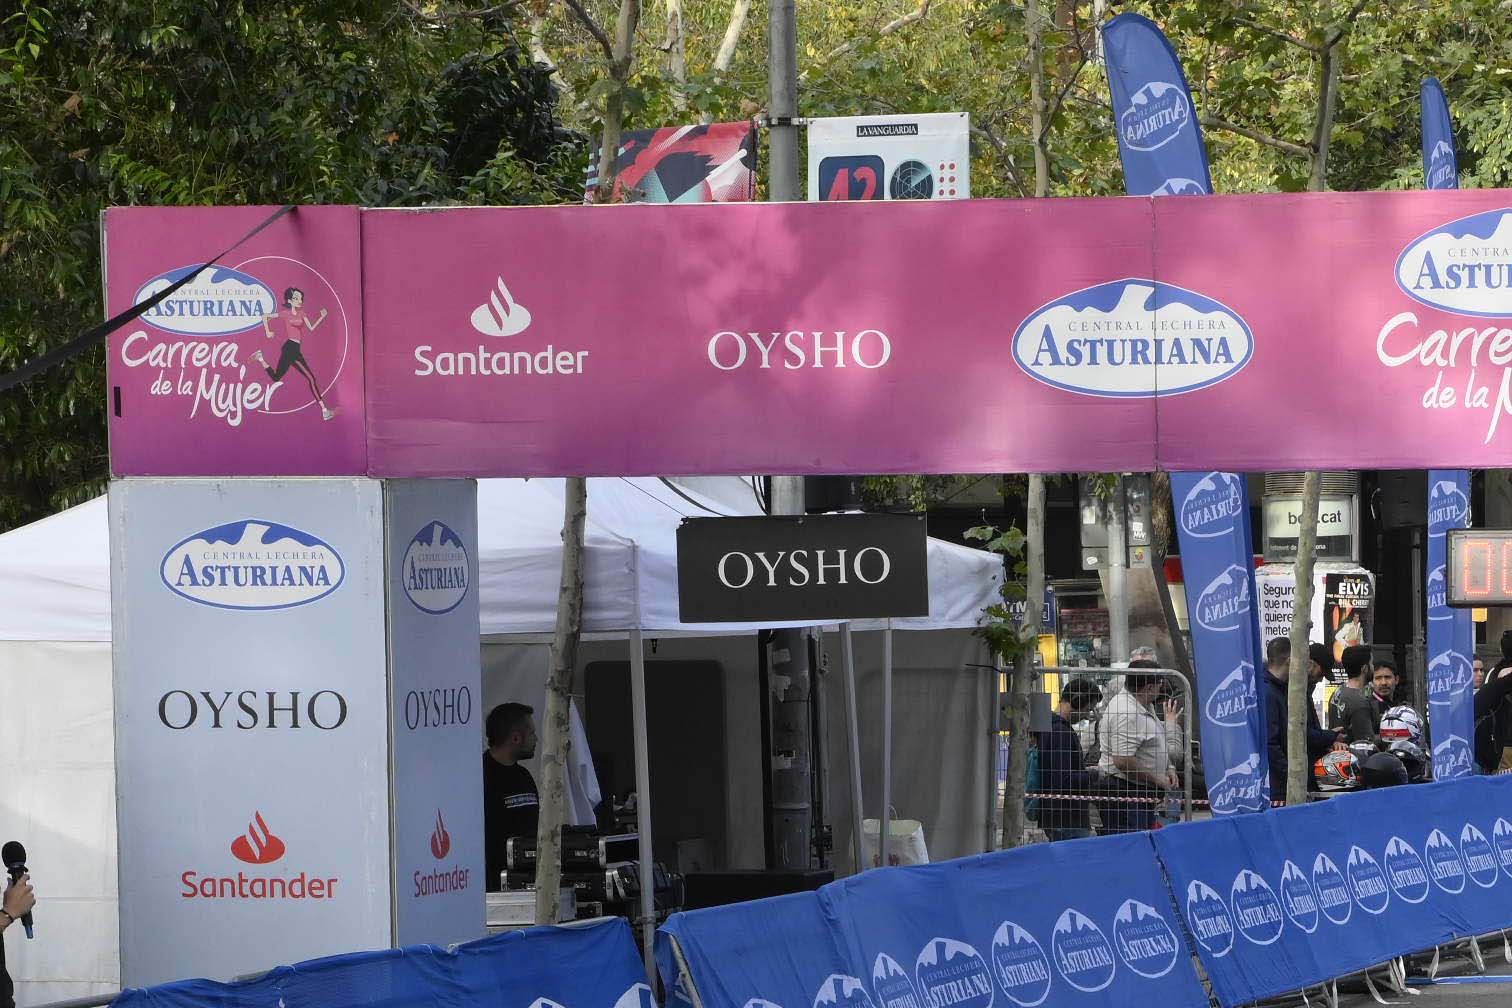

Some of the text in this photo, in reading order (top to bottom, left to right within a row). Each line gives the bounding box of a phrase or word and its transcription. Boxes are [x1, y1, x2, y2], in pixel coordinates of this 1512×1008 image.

[858, 125, 917, 135] LA VANGUARDIA
[1068, 319, 1228, 332] CENTRAL LECHERA
[121, 330, 240, 368] Carrera
[413, 344, 590, 377] Santander
[707, 329, 892, 371] OYSHO
[1031, 323, 1235, 368] ASTURIANA
[150, 364, 284, 428] de la Mujer
[1422, 372, 1457, 409] de
[1464, 369, 1490, 410] la
[175, 553, 332, 588] ASTURIANA
[203, 551, 326, 561] CENTRAL LECHERA
[407, 555, 467, 591] ASTURIANA
[717, 546, 891, 589] OYSHO
[1264, 600, 1281, 611] que
[1338, 582, 1369, 596] ELVIS
[158, 689, 348, 730] OYSHO
[404, 685, 472, 731] OYSHO
[182, 871, 339, 899] Santander
[413, 863, 470, 898] Santander
